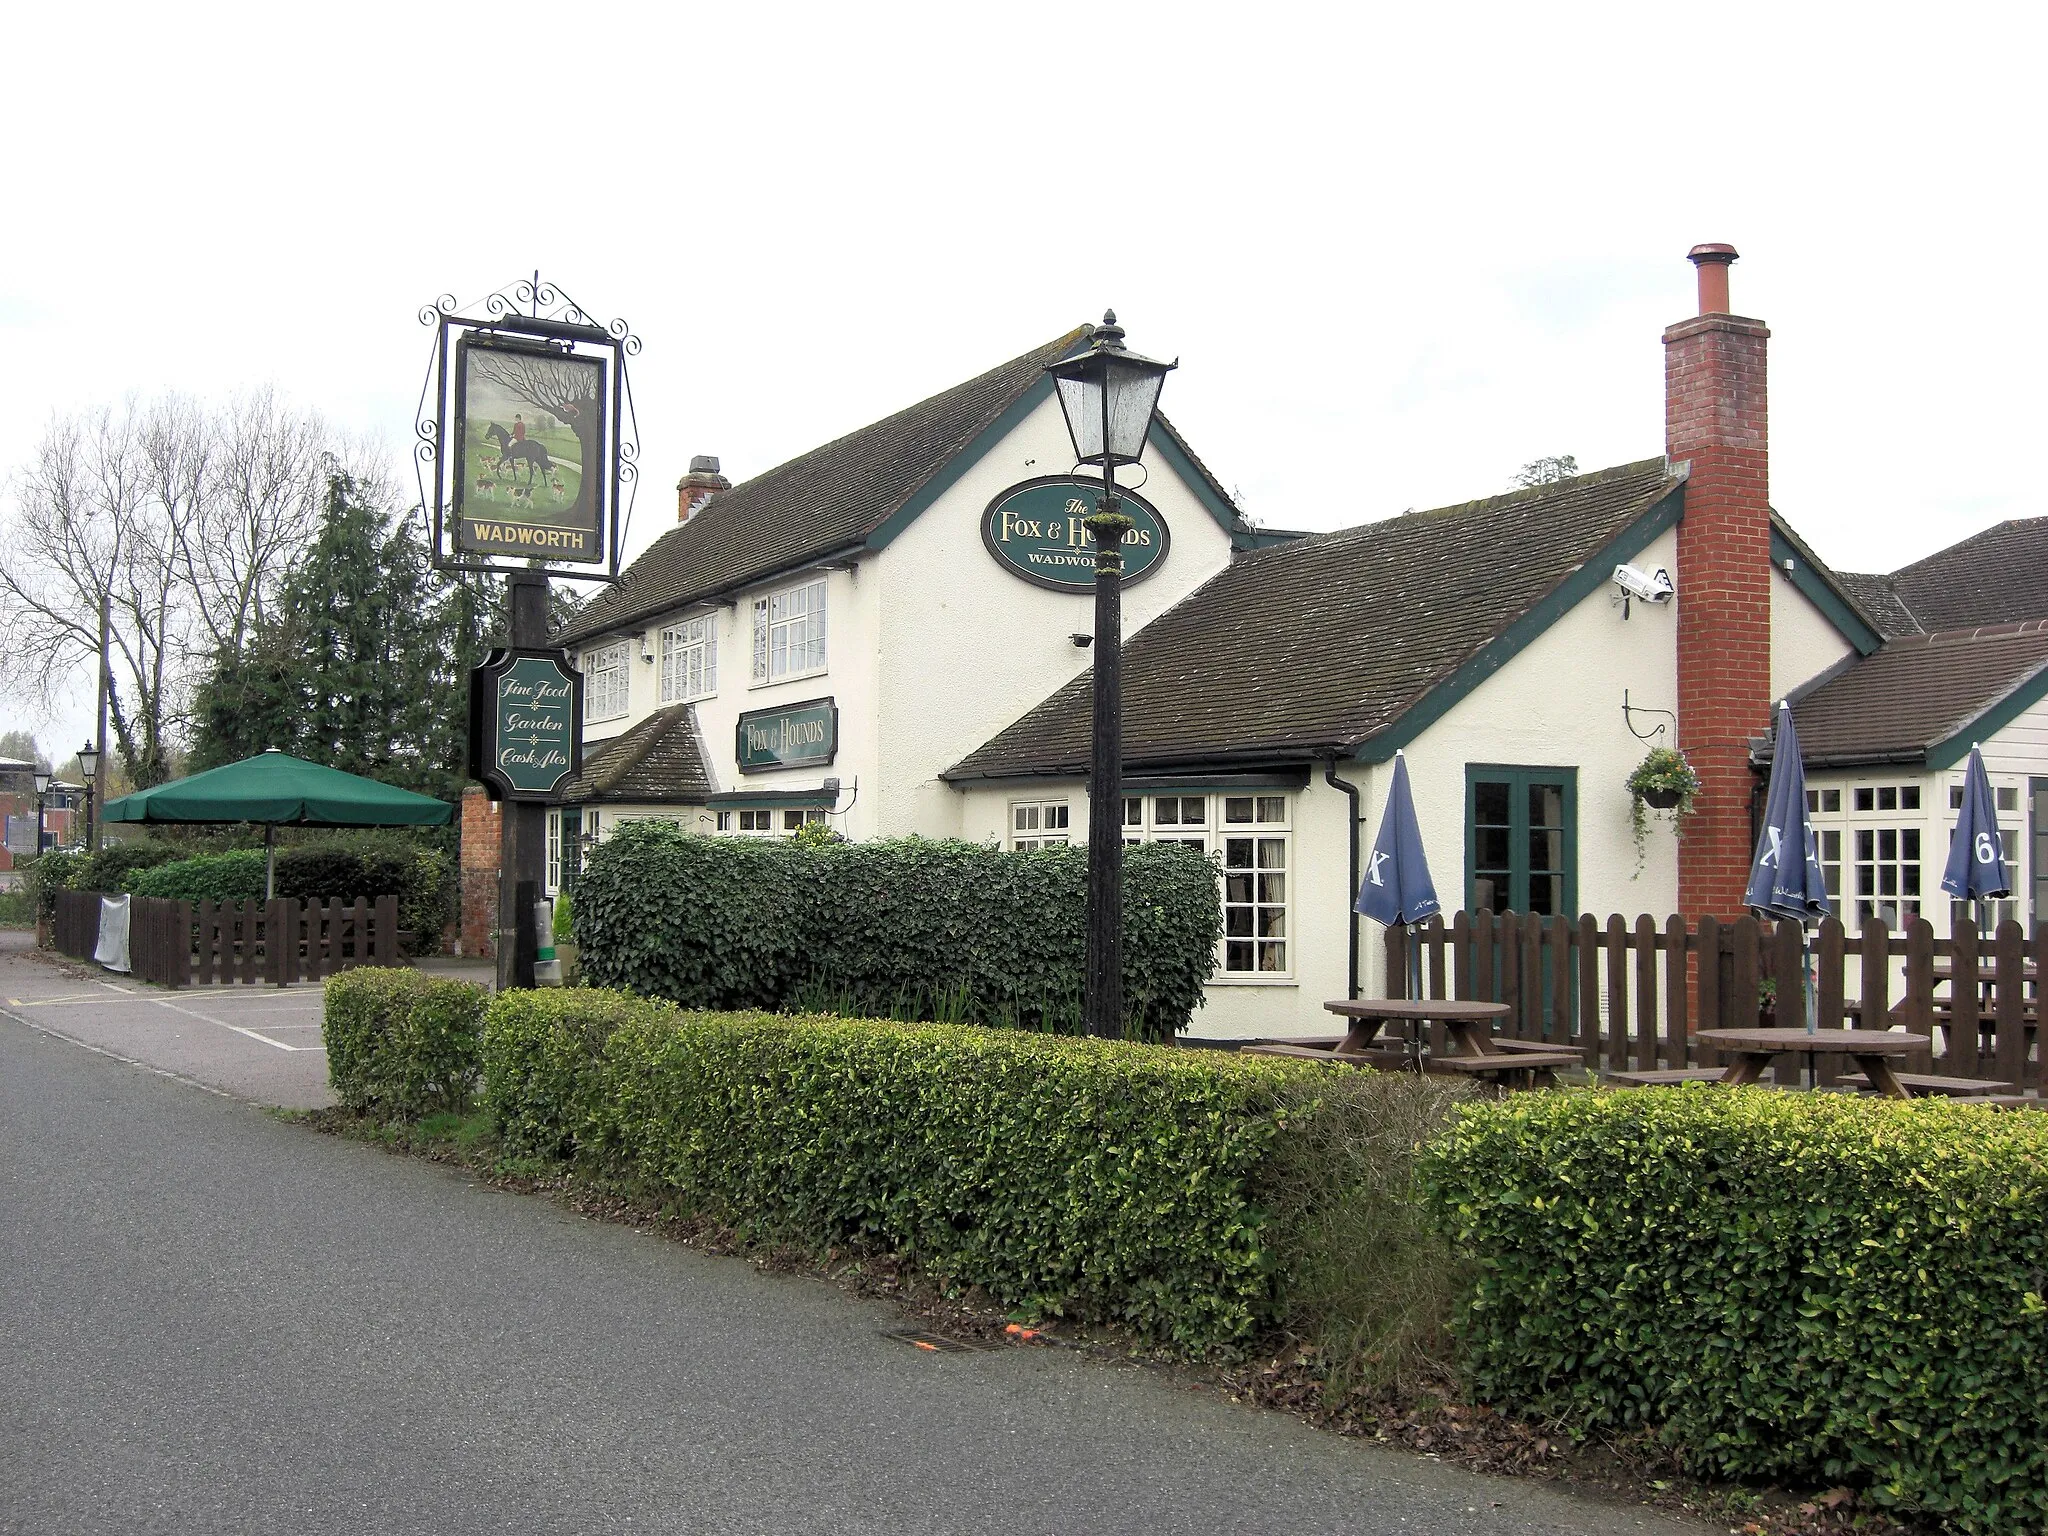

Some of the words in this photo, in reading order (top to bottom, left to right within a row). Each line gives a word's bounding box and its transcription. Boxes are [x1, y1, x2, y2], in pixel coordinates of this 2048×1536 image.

[1064, 498, 1089, 514] The
[473, 523, 583, 549] WADWORTH
[1047, 521, 1061, 539] &
[1067, 517, 1150, 548] HDS
[1027, 553, 1126, 570] WADWO
[500, 678, 533, 698] Fine
[532, 680, 570, 700] Food
[504, 712, 563, 732] Garden
[771, 728, 777, 748] &
[780, 718, 824, 754] HOUNDS
[500, 747, 534, 766] Cask
[532, 750, 567, 769] Ales
[1975, 832, 1995, 864] 6
